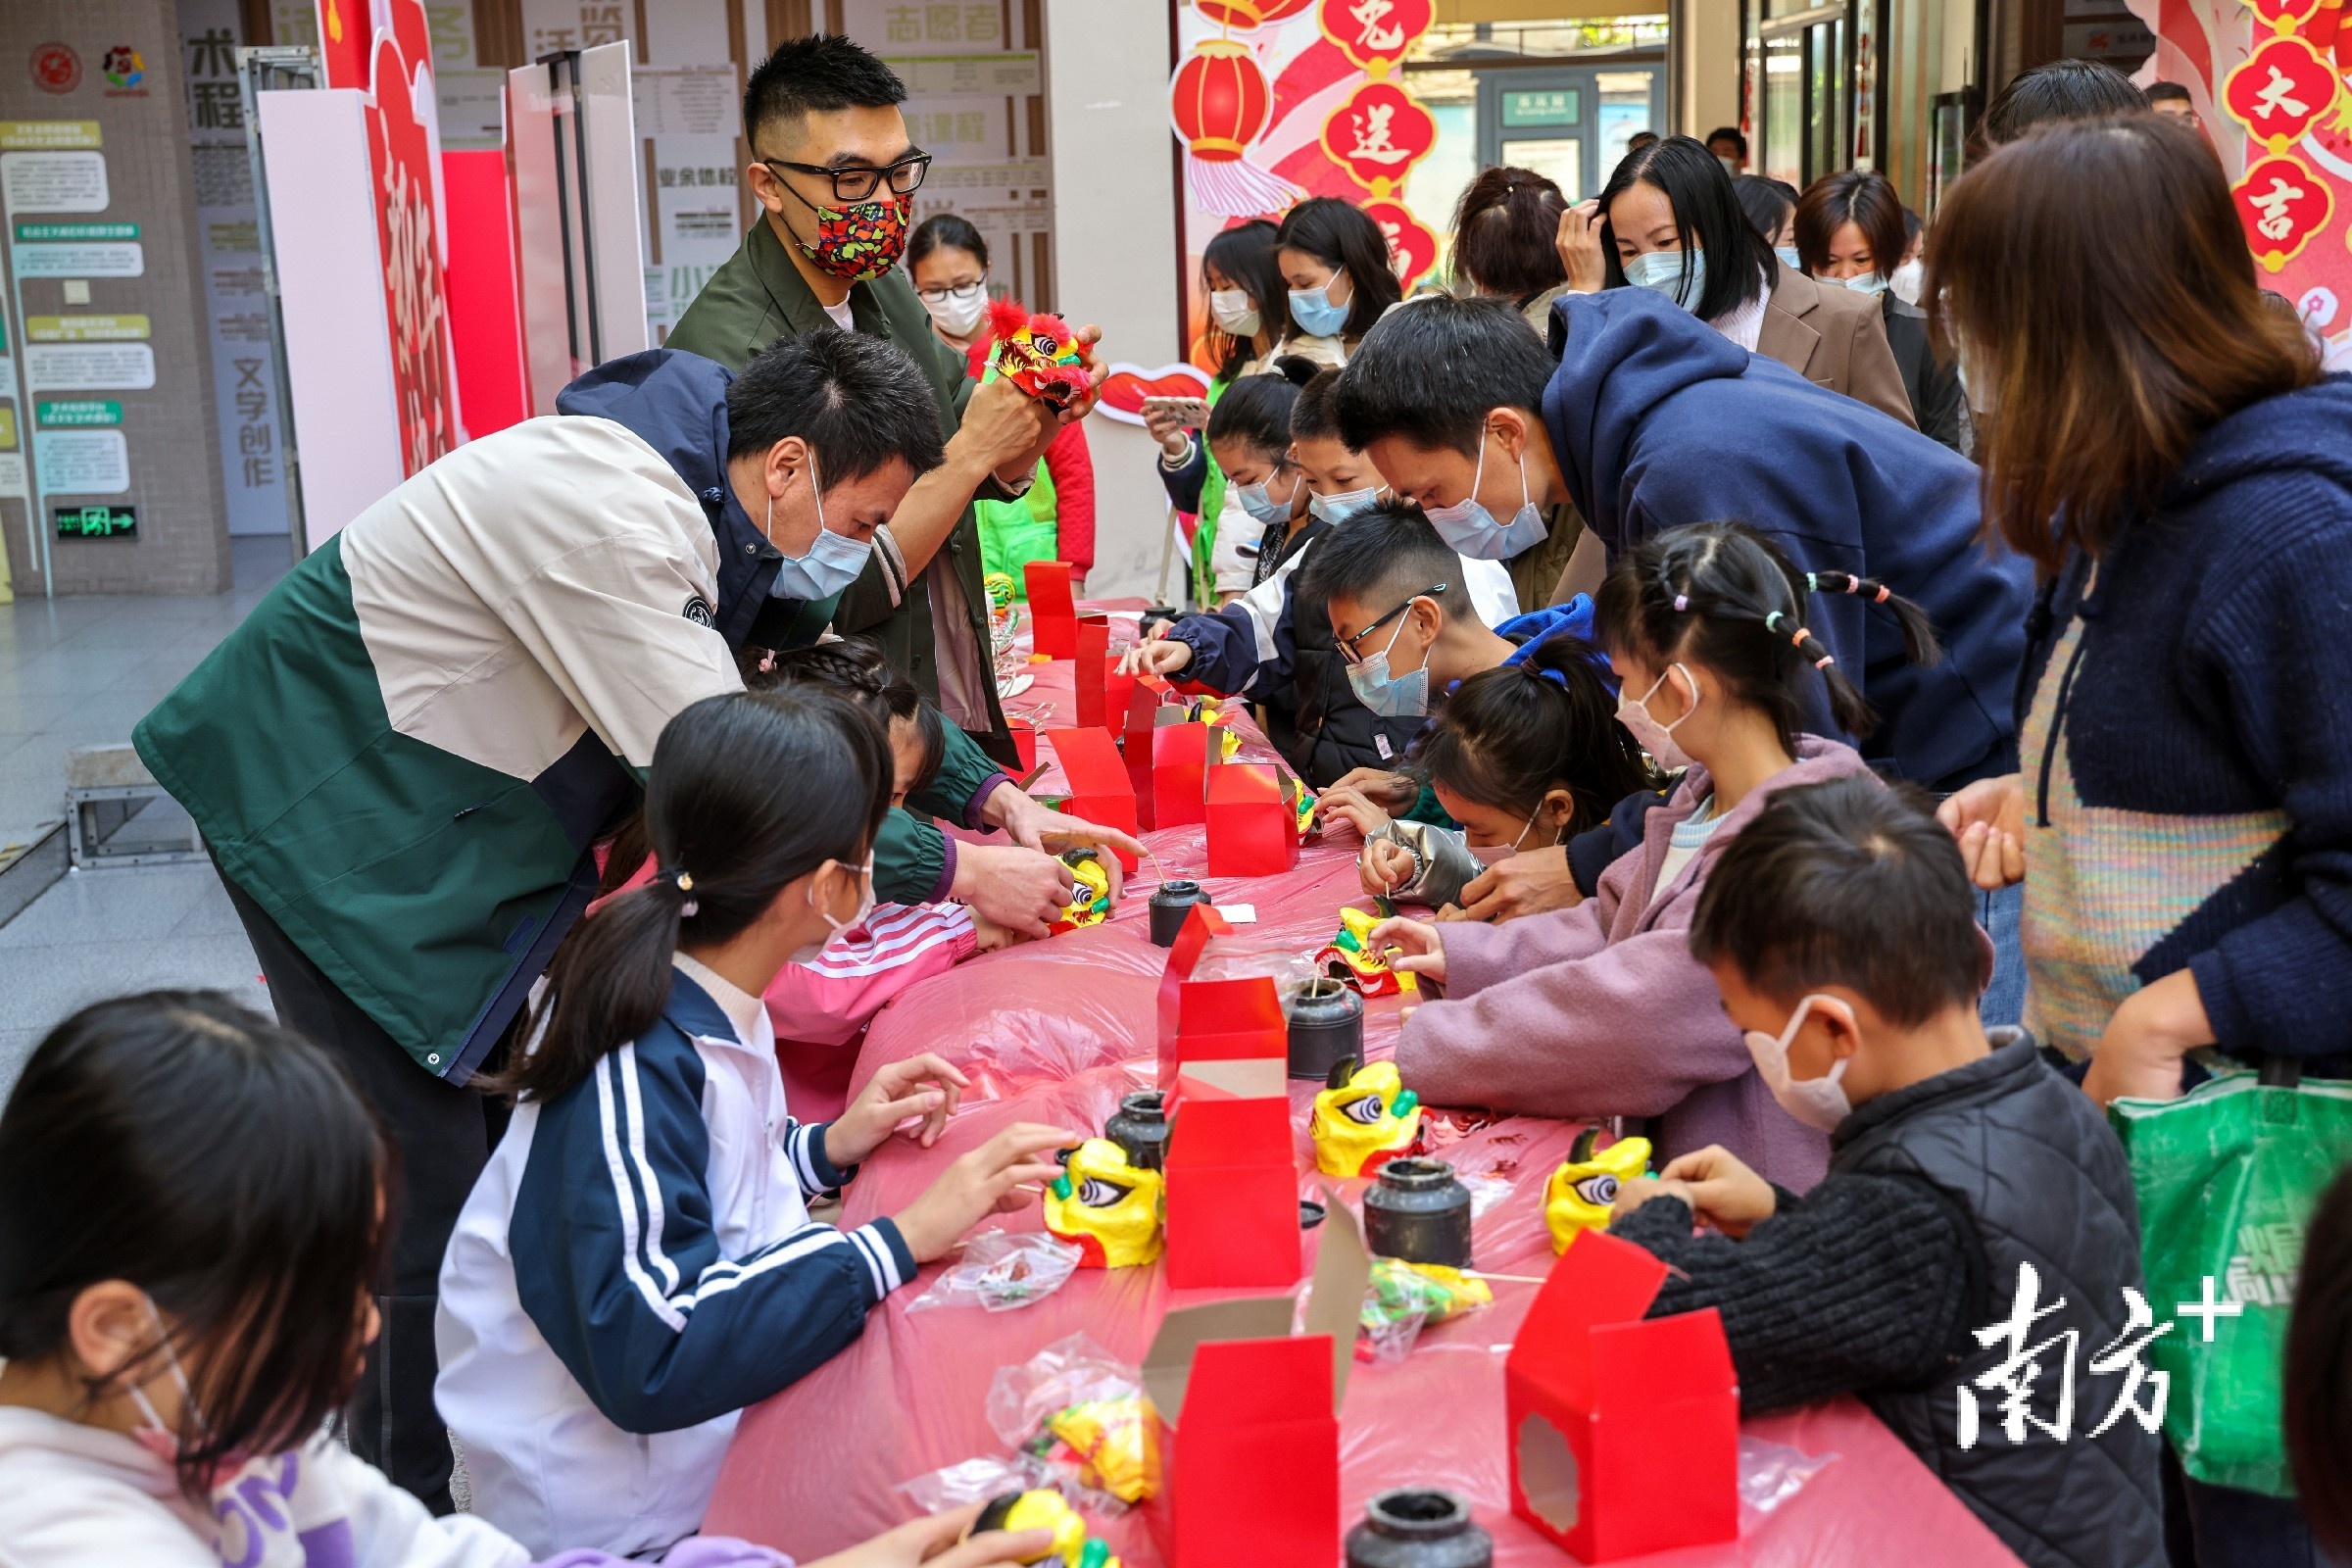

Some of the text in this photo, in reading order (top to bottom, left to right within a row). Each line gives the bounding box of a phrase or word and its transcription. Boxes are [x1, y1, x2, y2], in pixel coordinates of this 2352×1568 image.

[885, 5, 1000, 43] 志愿者
[179, 27, 237, 77] 术
[184, 82, 245, 129] 程
[2247, 0, 2310, 240] 大吉
[659, 167, 738, 187] 业余体校
[232, 356, 276, 489] 文学创作
